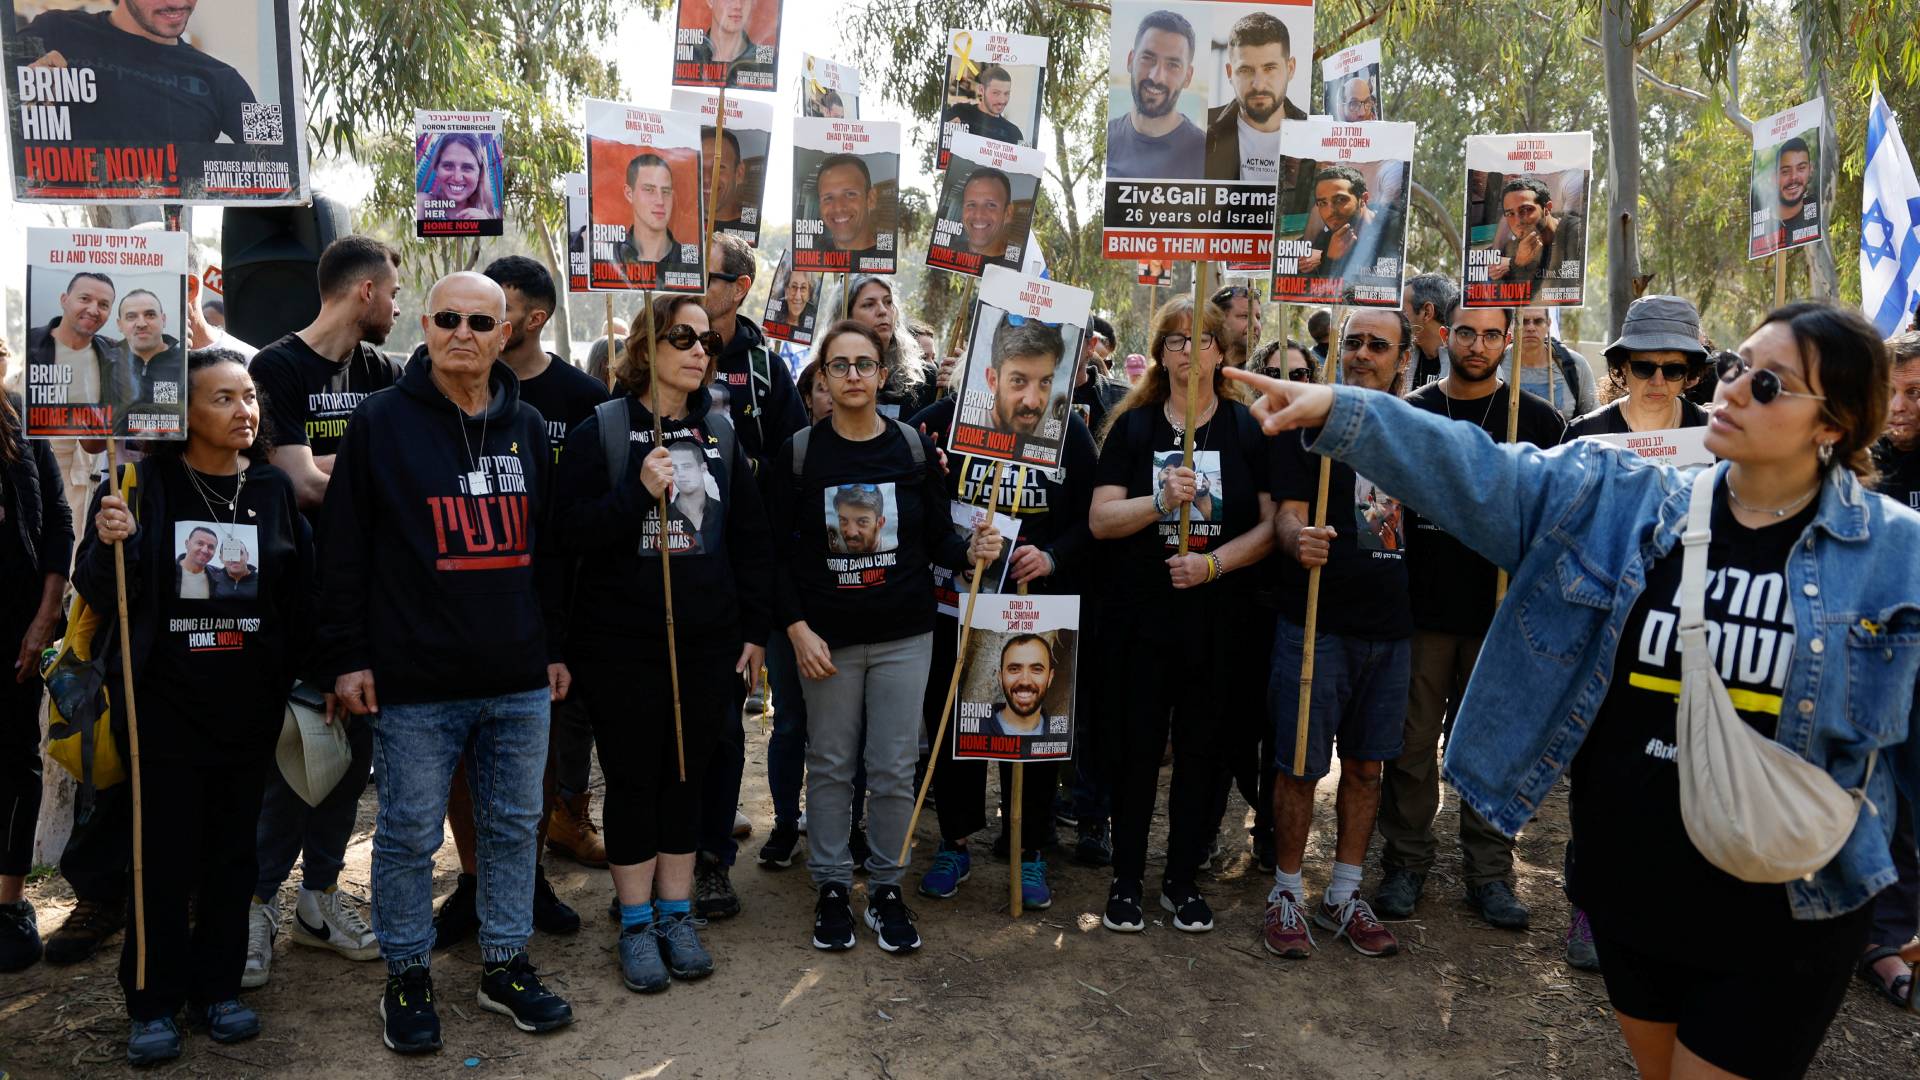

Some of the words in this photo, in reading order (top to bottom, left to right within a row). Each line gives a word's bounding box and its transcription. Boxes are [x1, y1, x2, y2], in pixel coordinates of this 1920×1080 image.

[677, 28, 704, 45] BRING
[676, 44, 694, 61] HIM
[675, 63, 700, 79] HOME
[17, 66, 97, 104] BRING
[21, 104, 72, 141] HIM
[942, 135, 952, 149] HI
[1321, 137, 1348, 148] NIMROD
[1348, 137, 1370, 148] COHEN
[1338, 149, 1351, 159] (19)
[1507, 151, 1532, 160] NIMROD
[1532, 150, 1553, 160] COHEN
[24, 146, 100, 182] HOME
[104, 143, 179, 183] NOW!
[203, 160, 241, 173] HOSTAGES
[241, 161, 257, 173] AND
[257, 162, 289, 174] MISSING
[1246, 157, 1259, 167] ACT
[1259, 158, 1276, 168] NOW
[205, 173, 251, 189] FAMILIES
[252, 173, 290, 189] FORUM
[1118, 185, 1206, 206] Ziv&Gali
[1215, 187, 1277, 206] Berma
[424, 199, 456, 209] BRING
[424, 209, 446, 218] HER
[1125, 208, 1143, 222] 26
[1150, 210, 1192, 226] years
[1197, 209, 1222, 223] old
[1227, 210, 1274, 224] Israeli
[423, 221, 454, 230] HOME
[455, 221, 479, 230] NOW
[593, 223, 626, 243] BRING
[795, 219, 824, 235] BRING
[936, 218, 963, 236] BRING
[72, 233, 102, 248] שרעבי
[105, 234, 127, 248] ויוסי
[130, 235, 147, 249] אלי
[795, 234, 813, 249] HIM
[933, 231, 951, 247] HIM
[1108, 236, 1157, 253] BRING
[1162, 237, 1205, 254] THEM
[1210, 239, 1253, 255] HOME
[593, 242, 614, 261] HIM
[1277, 240, 1312, 258] BRING
[1468, 249, 1501, 265] BRING
[50, 250, 64, 263] ELI
[66, 250, 86, 263] AND
[89, 251, 117, 264] YOSSI
[120, 252, 164, 266] SHARABI
[570, 251, 588, 264] BRIN
[794, 250, 820, 265] HOME
[592, 262, 625, 281] HOME
[1276, 257, 1298, 275] HIM
[1468, 265, 1489, 282] HIM
[1275, 277, 1307, 294] HOME
[1467, 283, 1498, 300] HOME
[1499, 281, 1531, 299] NOW!
[1019, 291, 1036, 305] DAVID
[29, 364, 72, 384] BRING
[728, 371, 748, 384] NOW
[29, 384, 69, 405] THEM
[962, 390, 996, 410] BRING
[29, 407, 69, 427] HOME
[72, 404, 113, 426] NOW!
[959, 406, 982, 426] HIM
[955, 425, 986, 447] HOME
[986, 431, 1017, 453] NOW!
[498, 474, 527, 493] אותם
[426, 496, 528, 554] עכשיו
[642, 519, 684, 535] HOSAGE
[1193, 524, 1209, 536] AND
[1209, 524, 1222, 536] ZIV
[642, 535, 655, 549] BY
[826, 557, 849, 573] BRING
[849, 556, 873, 571] DAVID
[838, 571, 862, 585] HOME
[1002, 610, 1013, 620] TAL
[1014, 610, 1040, 620] SHOHAM
[169, 618, 198, 632] BRING
[199, 618, 213, 630] ELI
[215, 618, 235, 630] AND
[189, 633, 217, 648] HOME
[217, 631, 244, 646] NOW!
[960, 702, 993, 719] BRING
[959, 718, 980, 734] HIM
[959, 735, 988, 751] HOME
[990, 735, 1021, 752] NOW!
